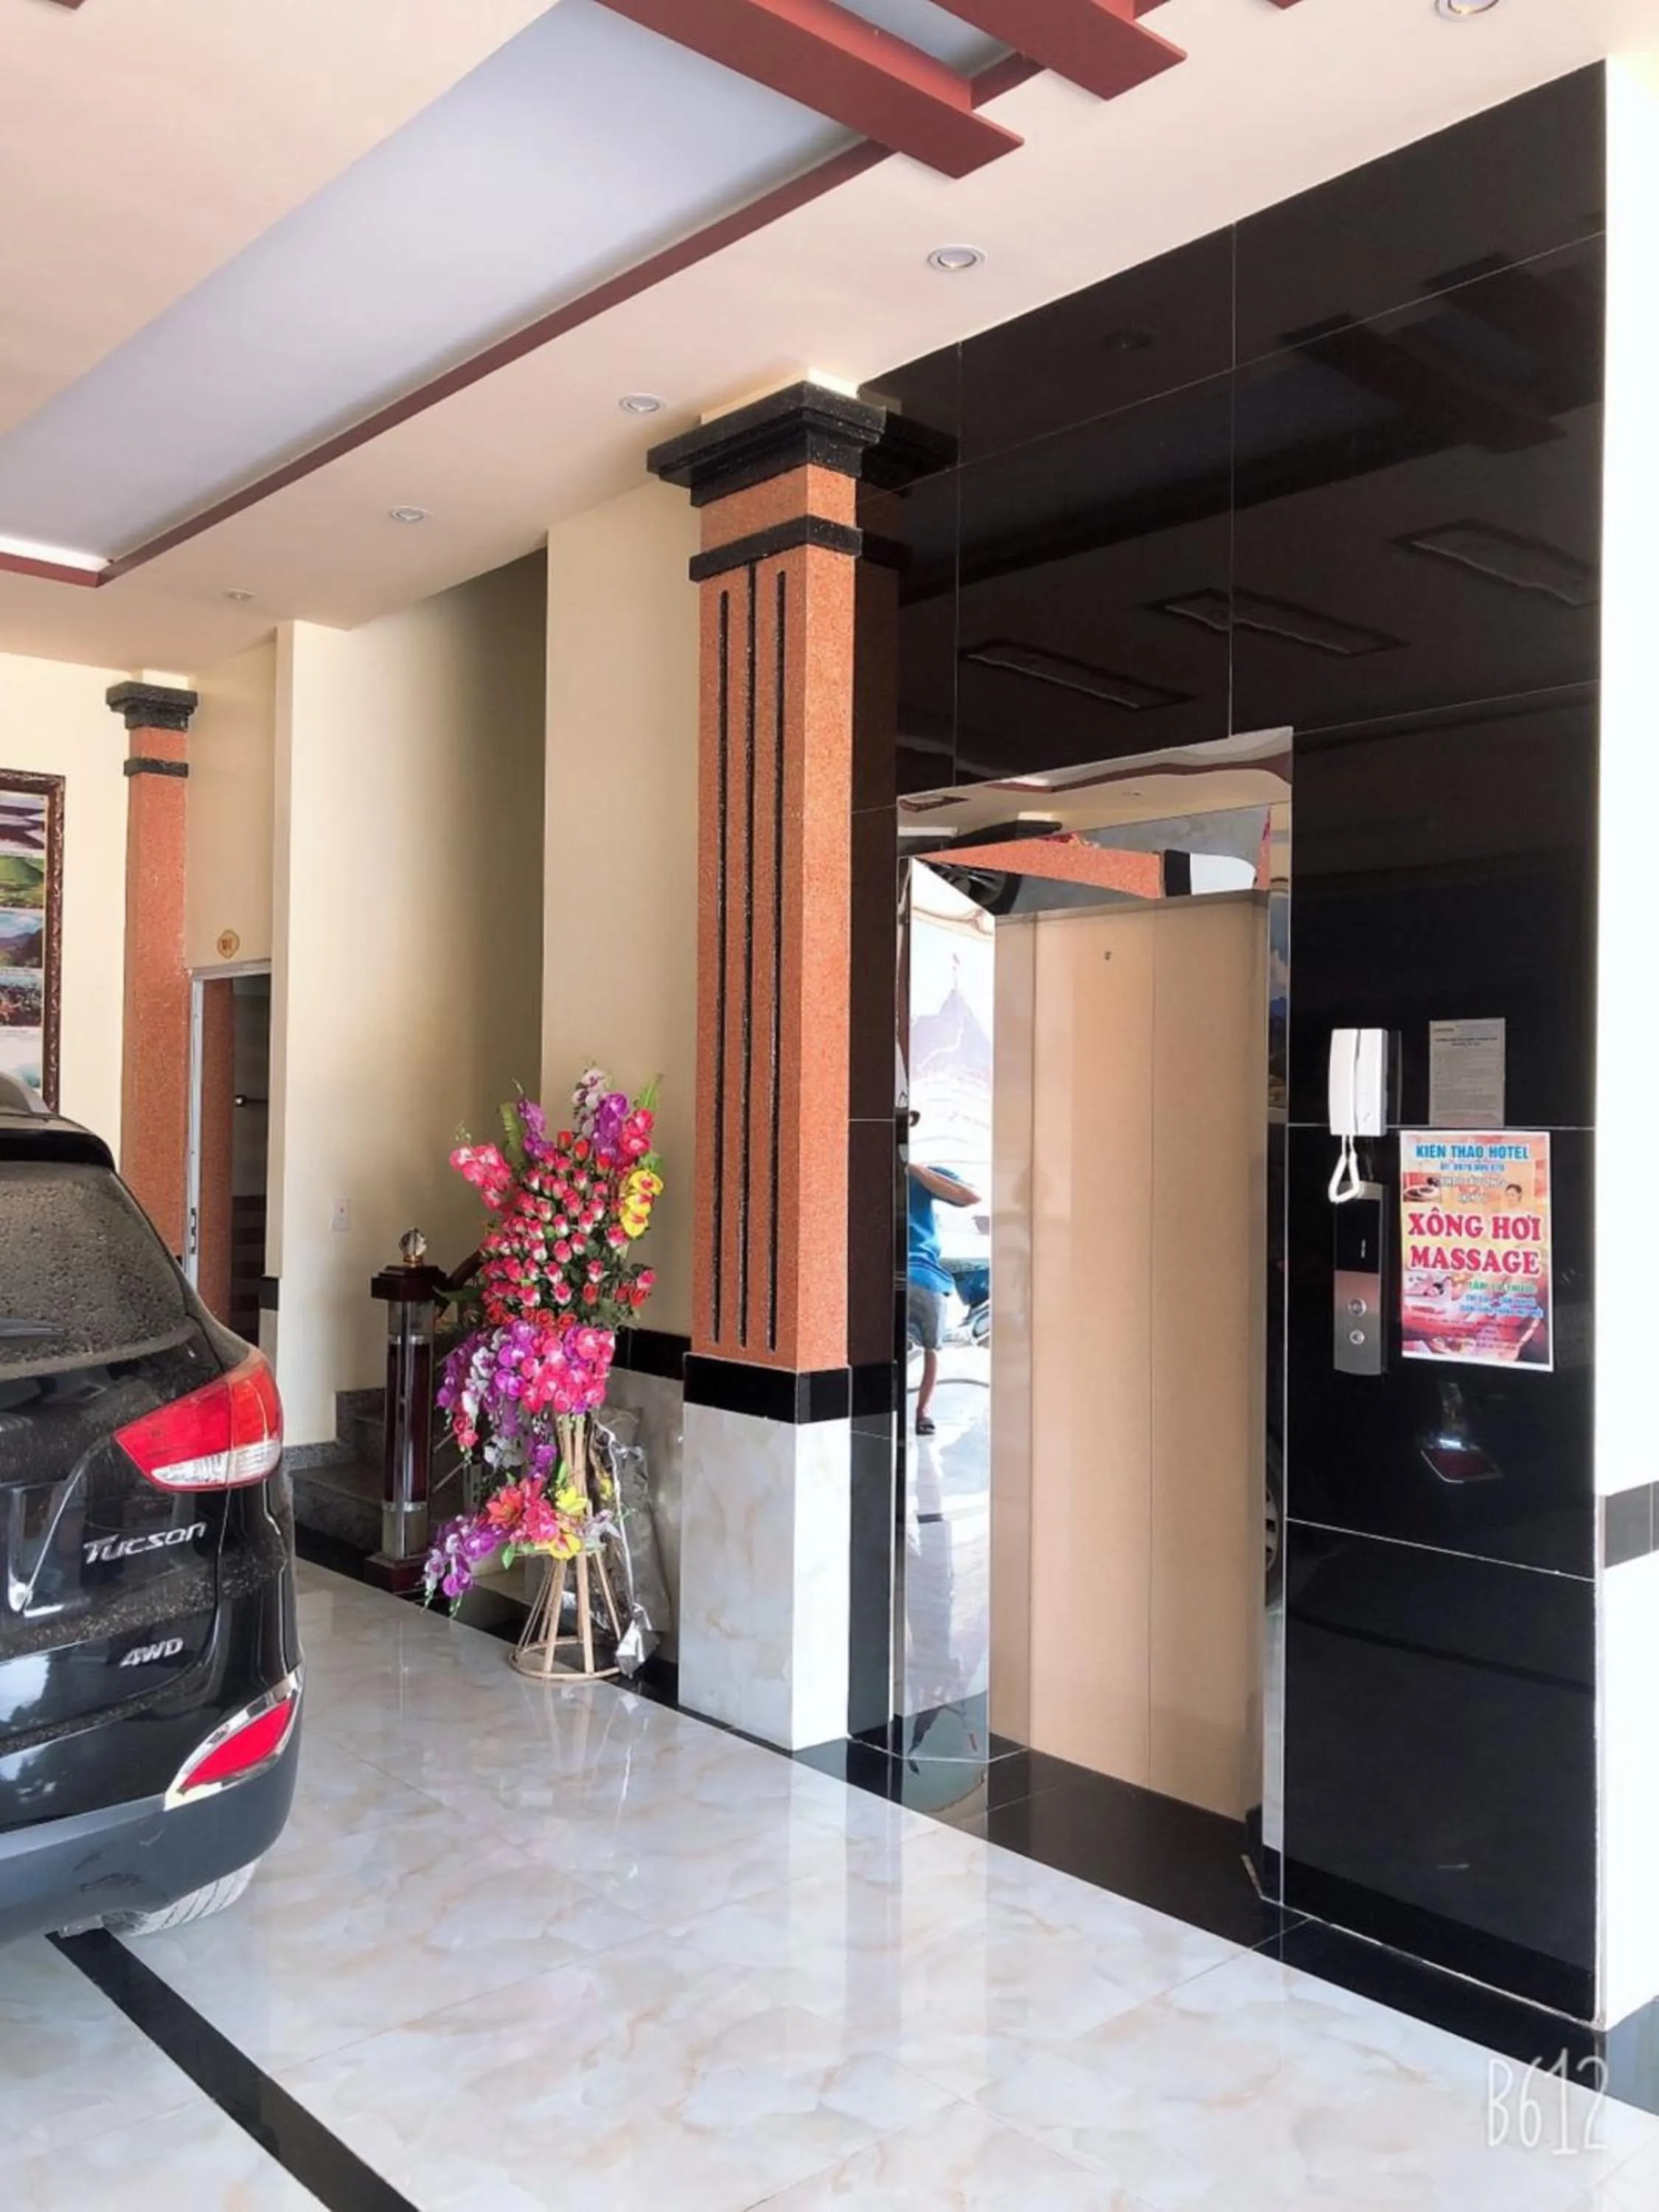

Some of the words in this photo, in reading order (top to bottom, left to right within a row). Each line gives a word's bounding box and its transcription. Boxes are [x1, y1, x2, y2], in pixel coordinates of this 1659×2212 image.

[1489, 1145, 1528, 1160] HOTEL
[1408, 1206, 1484, 1239] XÔNG
[1410, 1245, 1540, 1275] MASSAGE
[119, 1636, 184, 1669] 4WD
